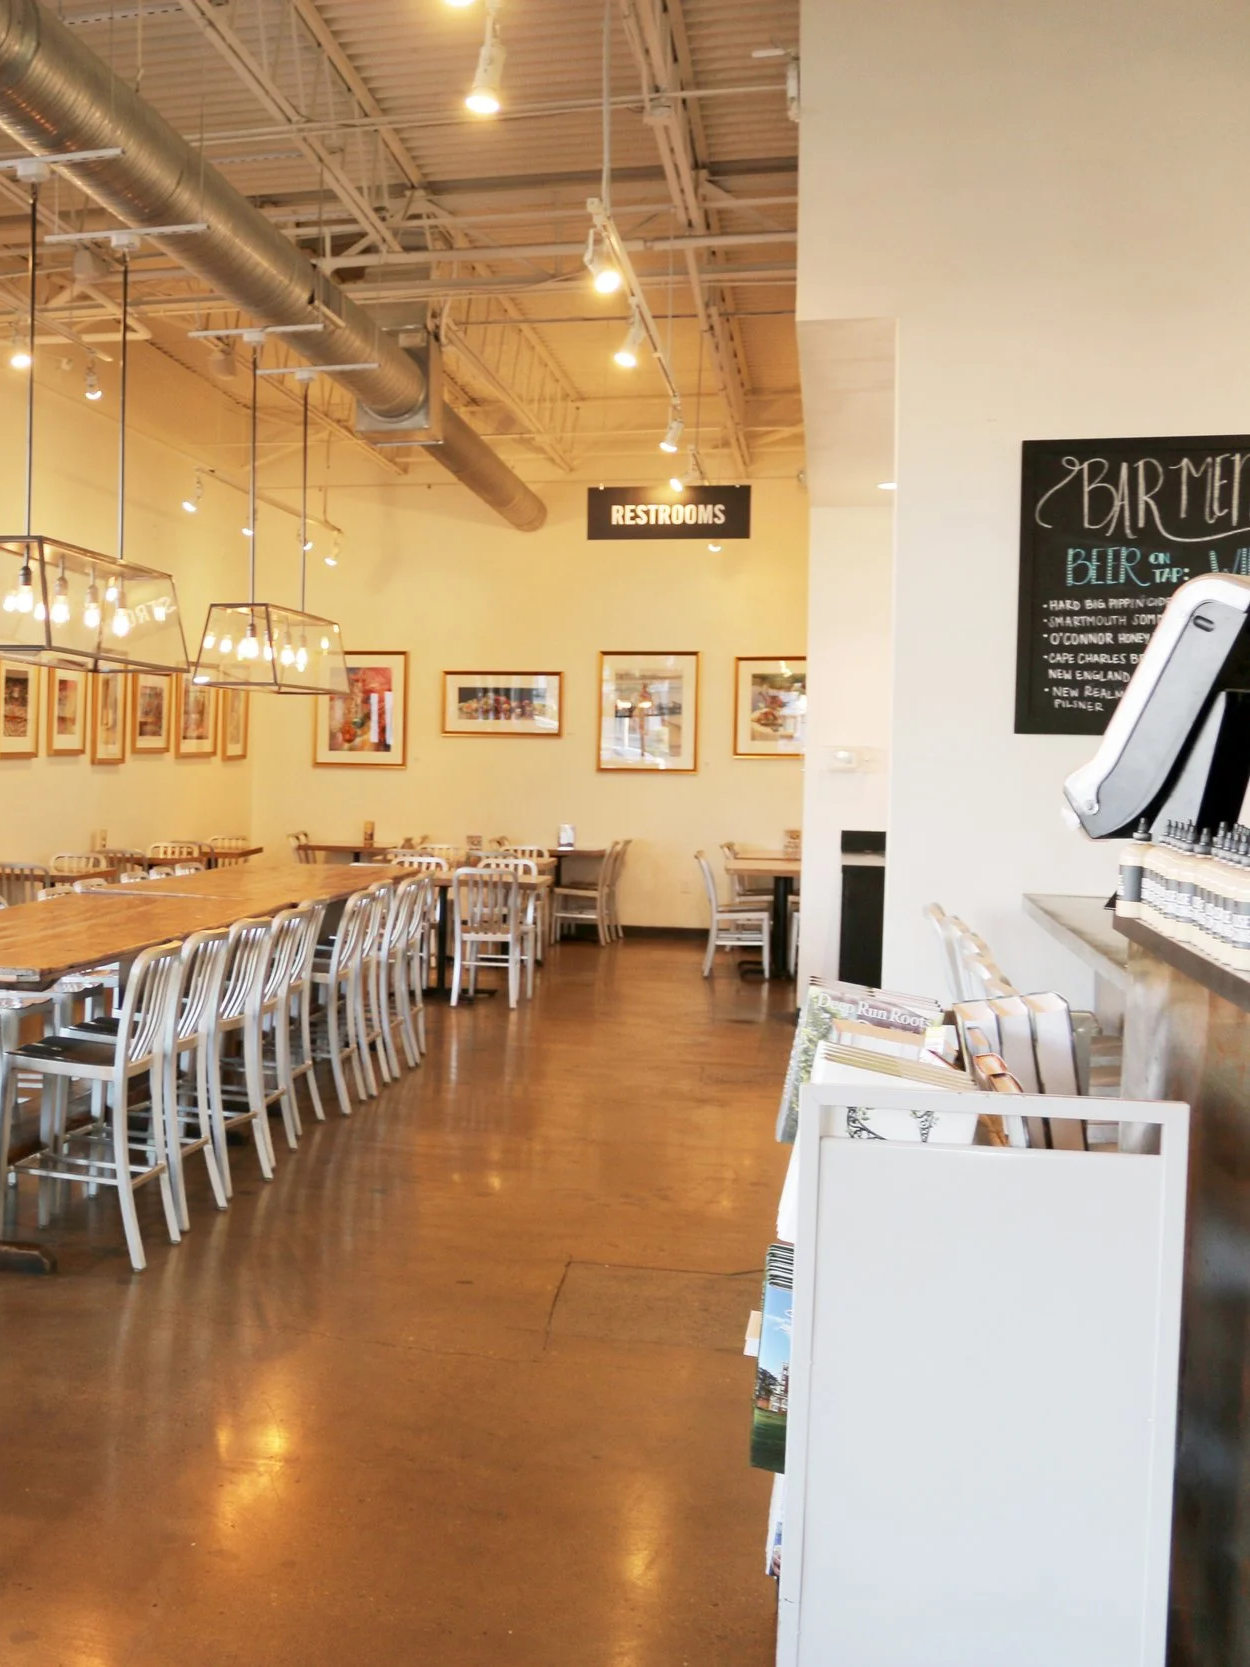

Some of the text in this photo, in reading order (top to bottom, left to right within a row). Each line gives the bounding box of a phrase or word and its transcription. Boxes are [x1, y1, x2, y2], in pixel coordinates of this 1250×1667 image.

[1036, 456, 1165, 539] BAR
[611, 504, 726, 525] RESTROOMS
[1066, 547, 1190, 586] BEER ON TAP:
[1049, 599, 1081, 611] HARD
[1084, 599, 1106, 610] BIG
[1048, 615, 1127, 628] SMARTMOUTH
[1050, 632, 1151, 646] O'CONNOR HONEY
[1048, 652, 1075, 664] CAPE
[1077, 652, 1127, 664] CHARLES
[1047, 668, 1131, 683] NEW ENGLAND
[1051, 686, 1079, 697] NEW
[1053, 699, 1105, 712] PILSNER
[817, 992, 856, 1017] Deep
[857, 1001, 888, 1021] Run
[889, 1008, 932, 1028] Roots
